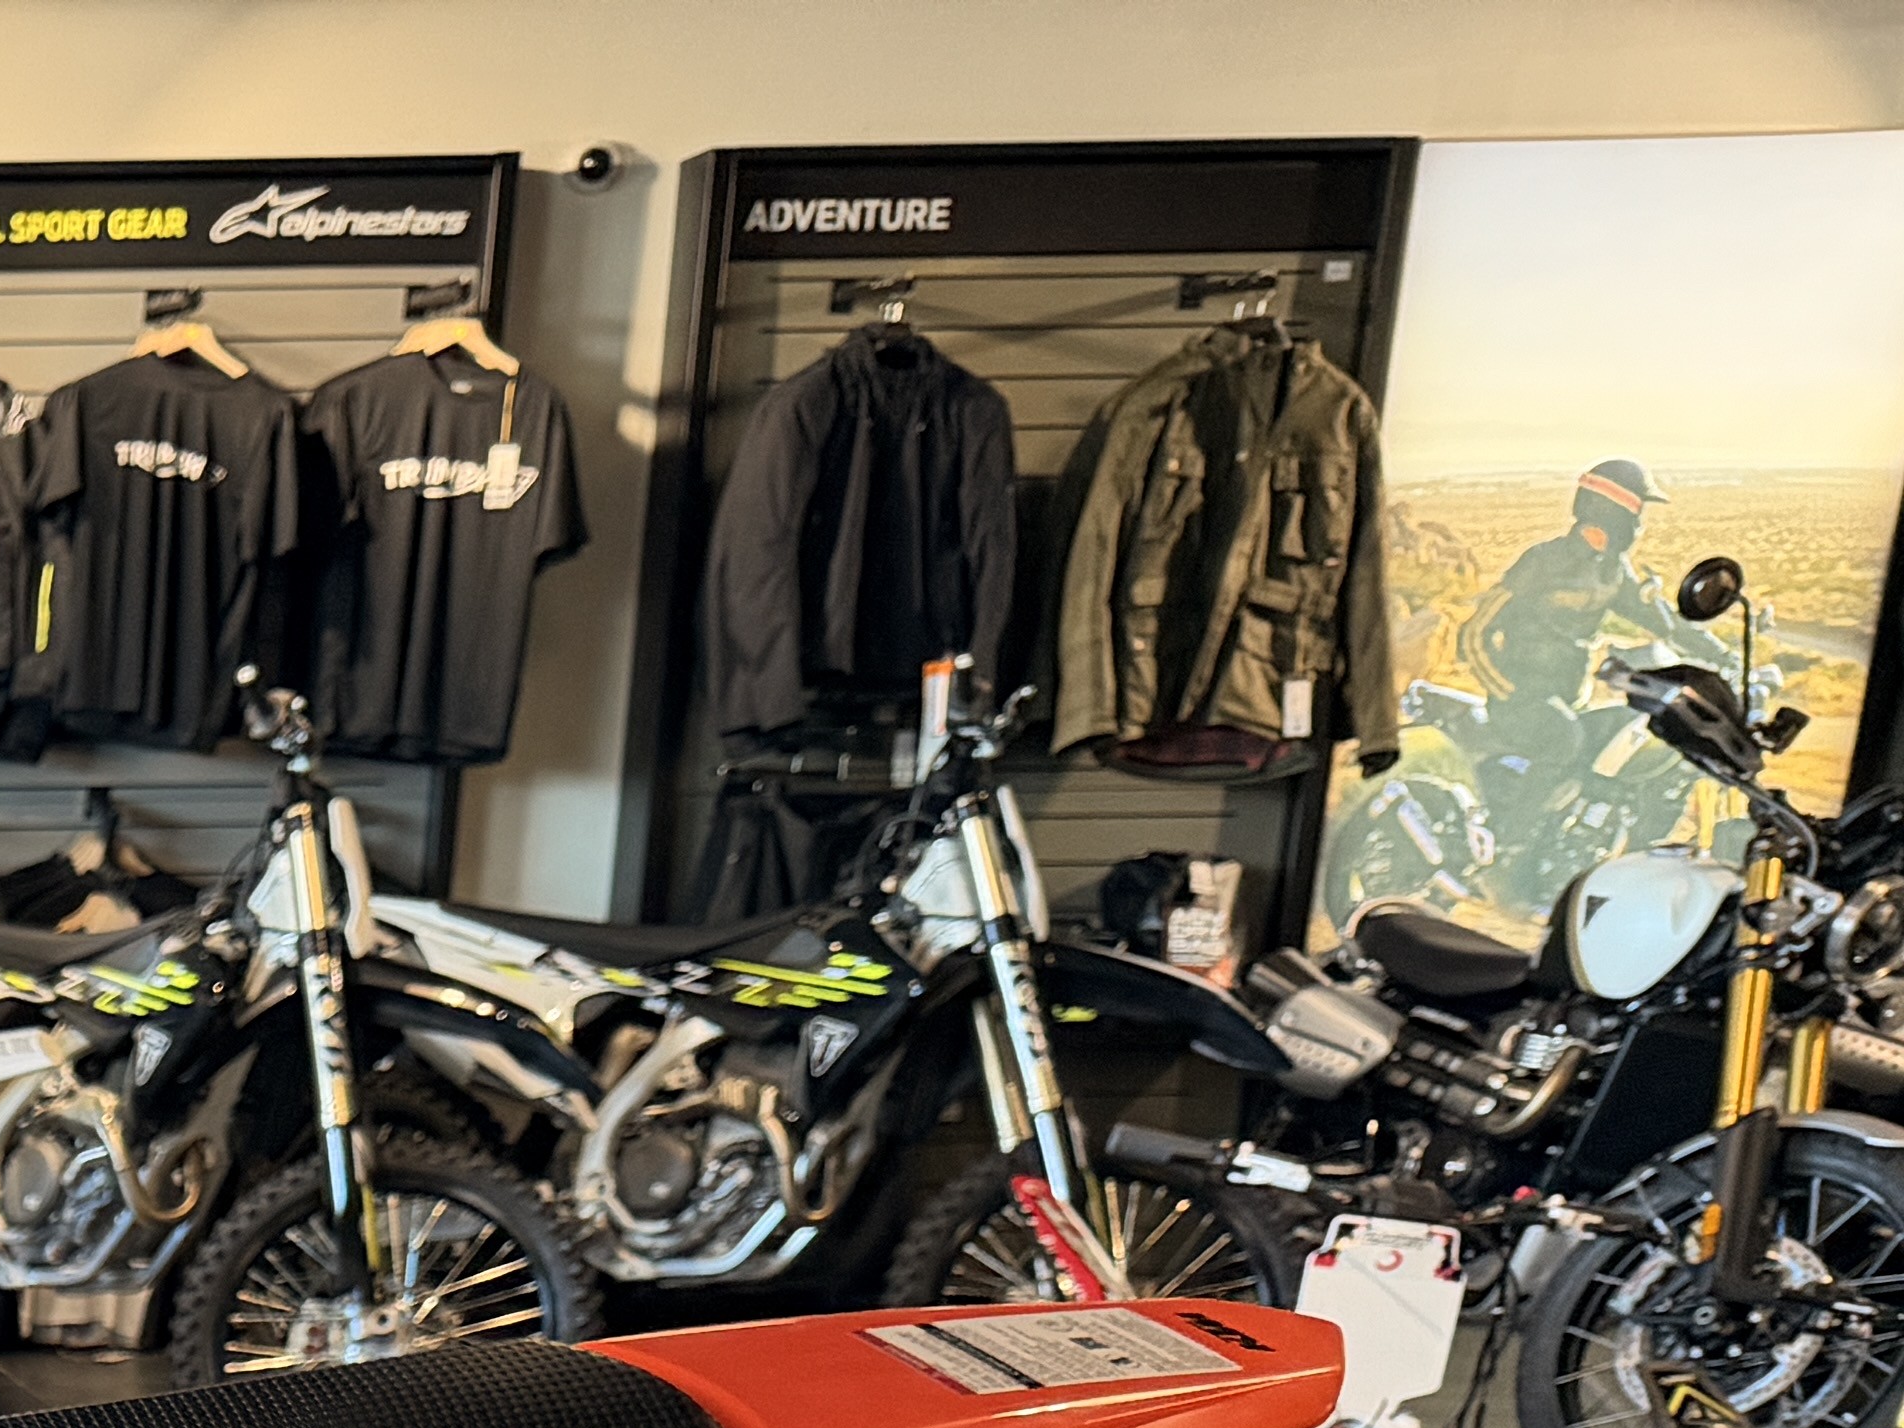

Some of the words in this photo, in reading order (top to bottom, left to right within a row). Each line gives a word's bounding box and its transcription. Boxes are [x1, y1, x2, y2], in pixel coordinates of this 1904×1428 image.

[9, 209, 104, 244] SPORT
[108, 207, 188, 240] GEAR
[743, 198, 952, 233] ADVENTURE
